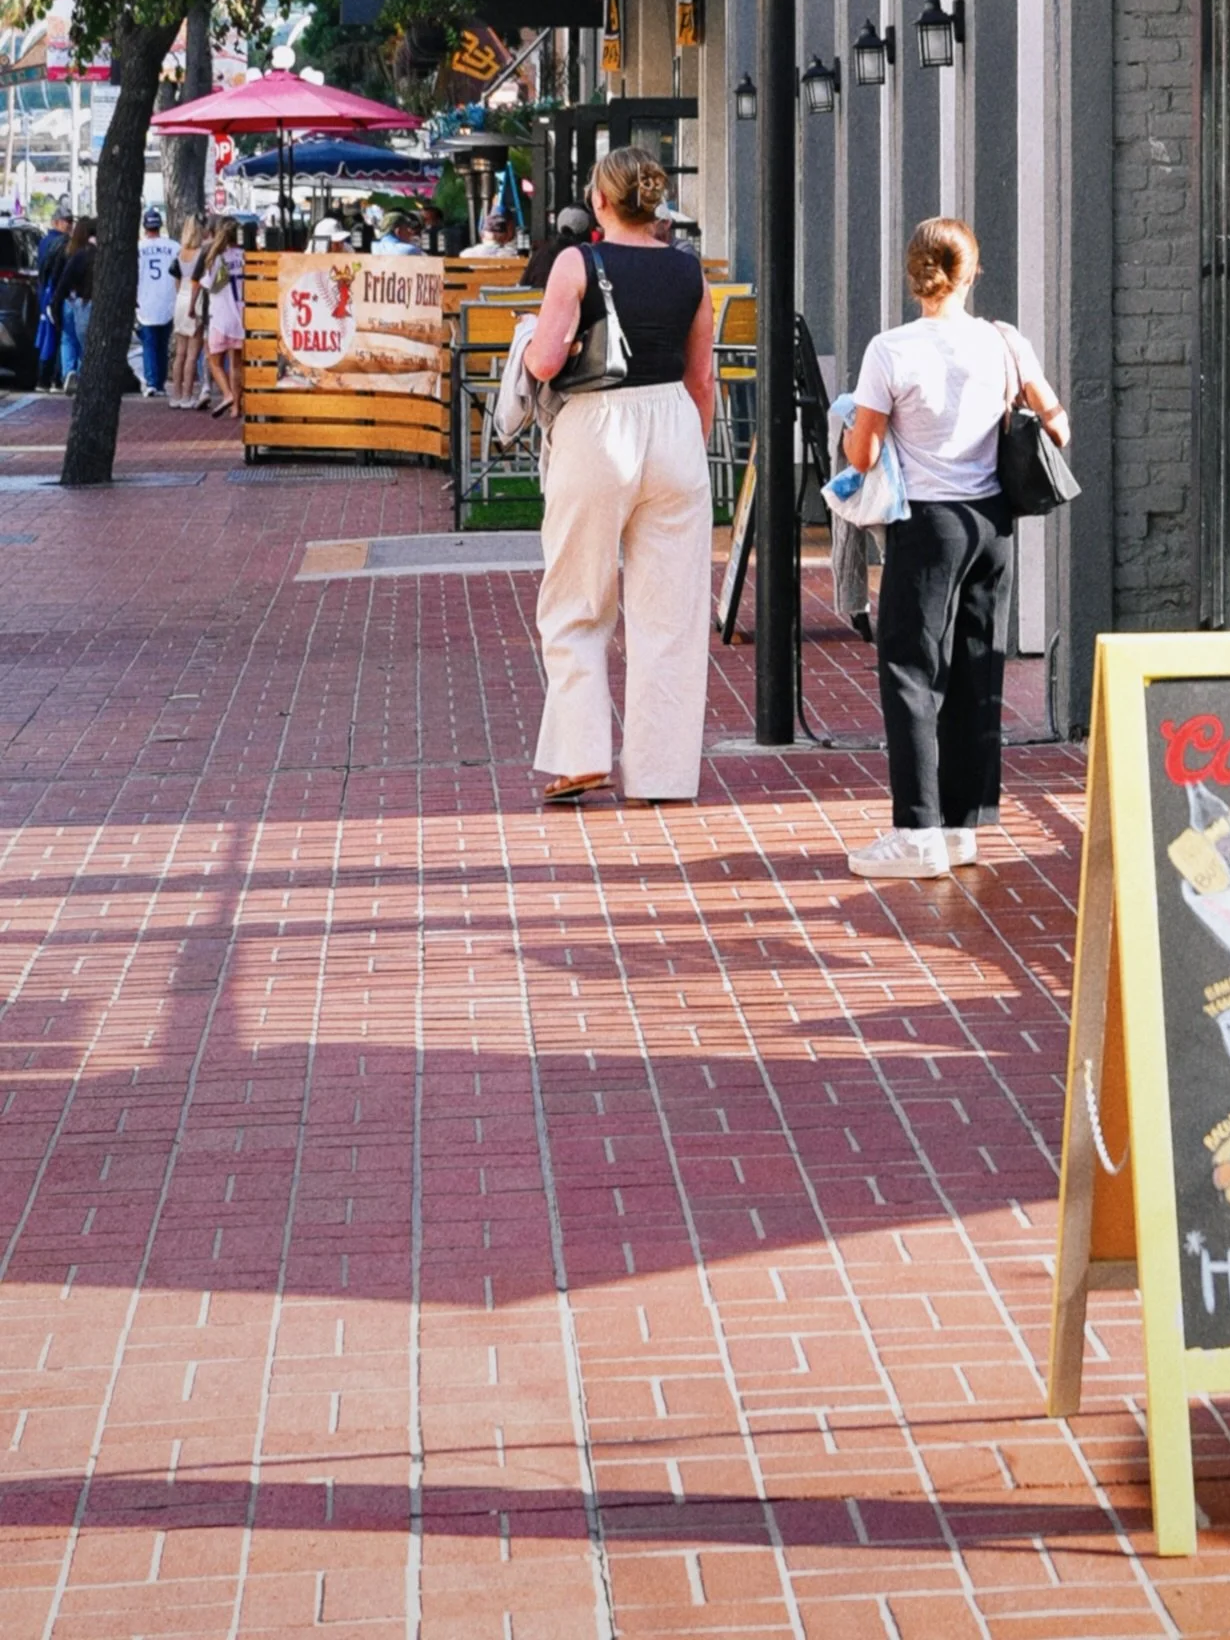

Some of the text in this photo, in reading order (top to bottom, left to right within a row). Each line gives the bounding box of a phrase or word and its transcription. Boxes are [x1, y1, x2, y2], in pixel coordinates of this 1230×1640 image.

[148, 258, 161, 280] 5
[363, 270, 412, 309] Friday
[292, 329, 341, 353] DEALS!
